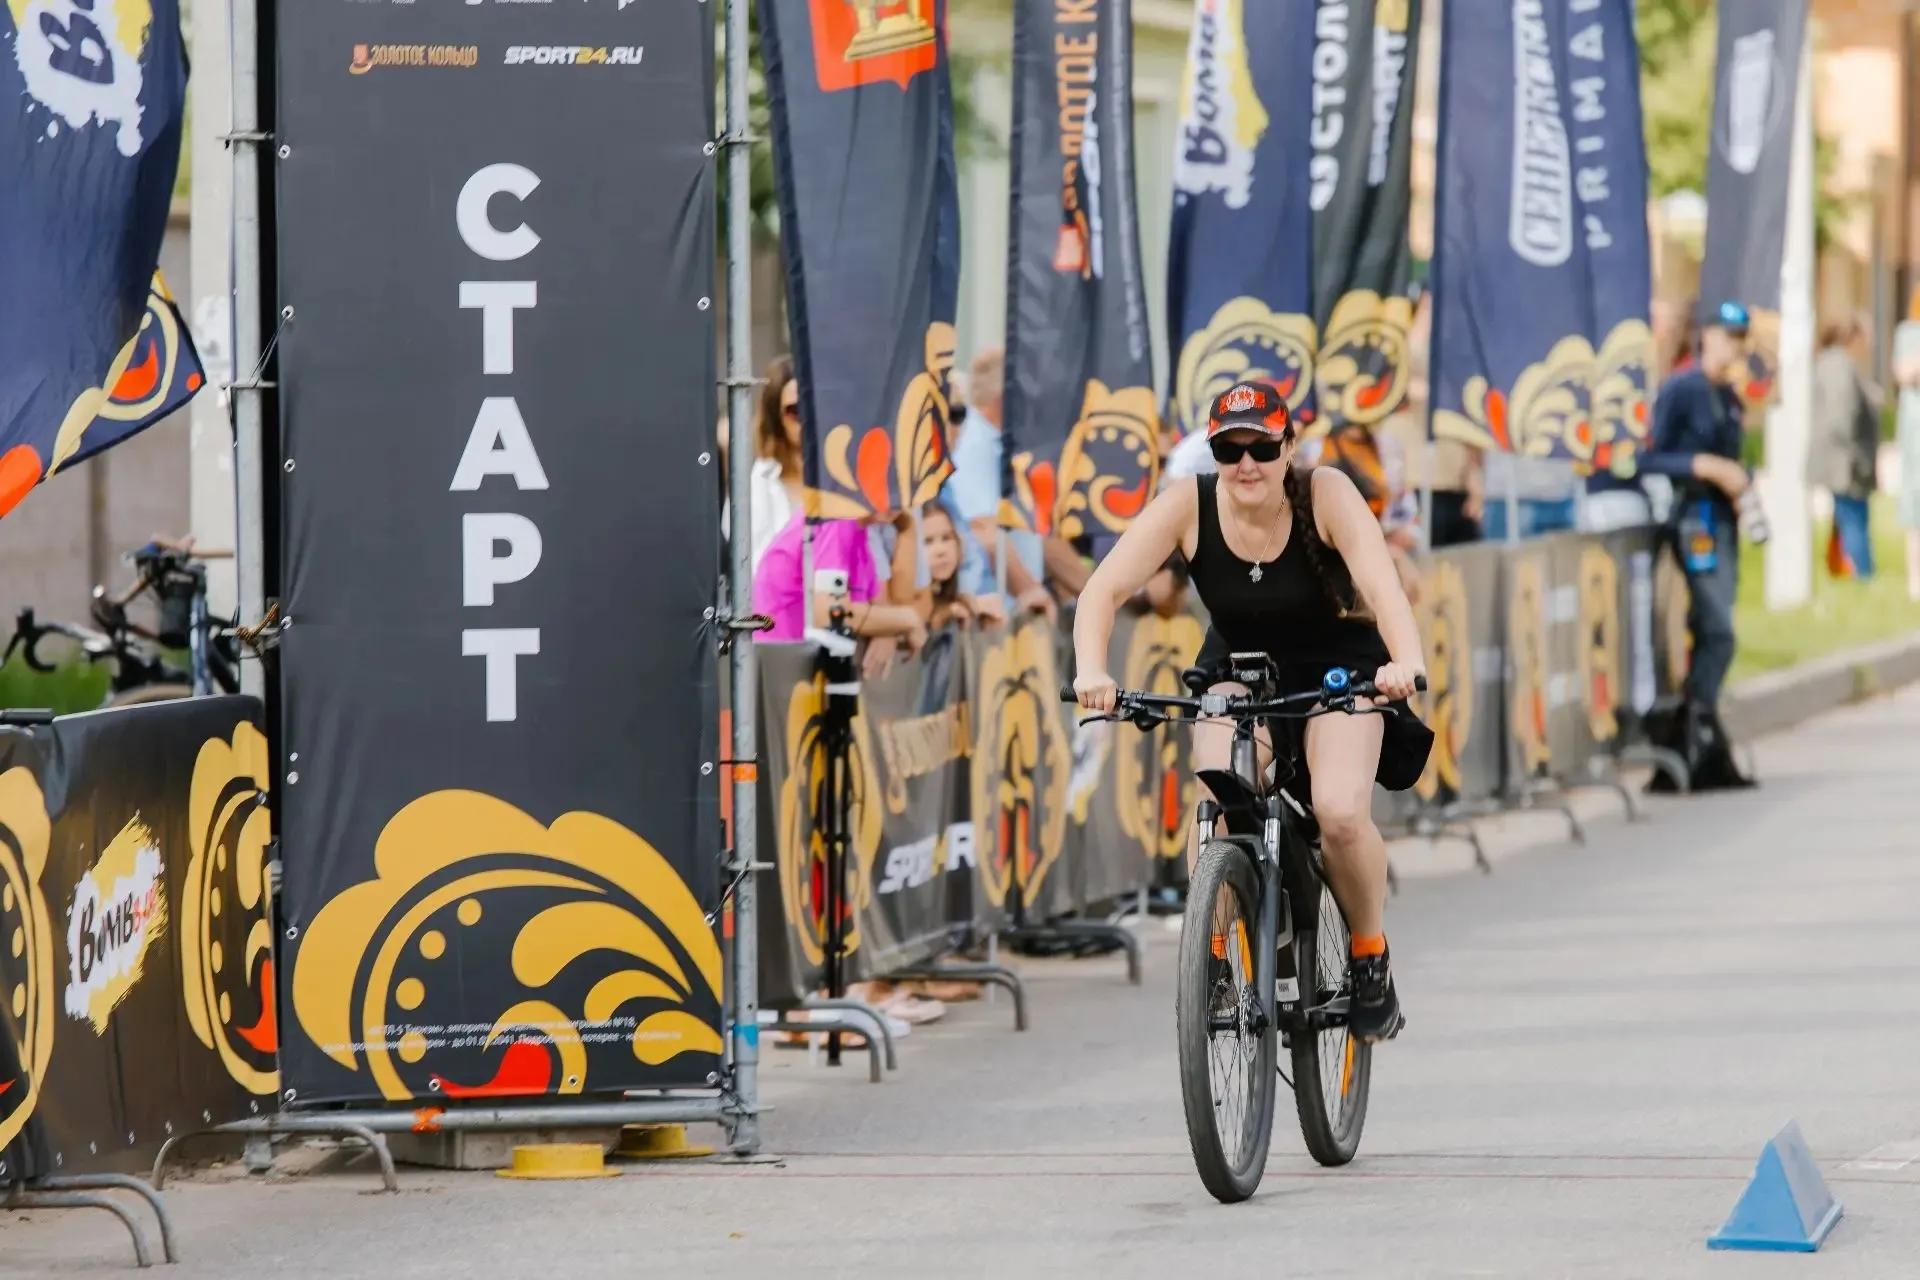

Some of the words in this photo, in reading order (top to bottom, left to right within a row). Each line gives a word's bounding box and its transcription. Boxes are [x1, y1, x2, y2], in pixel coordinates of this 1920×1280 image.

[370, 44, 427, 66] ЗОЛОТОЕ
[428, 44, 479, 68] КОЛЬЦО
[503, 45, 645, 66] SPORT24.RU
[1310, 0, 1349, 149] СТОЛ
[449, 162, 551, 723] СТАРТ
